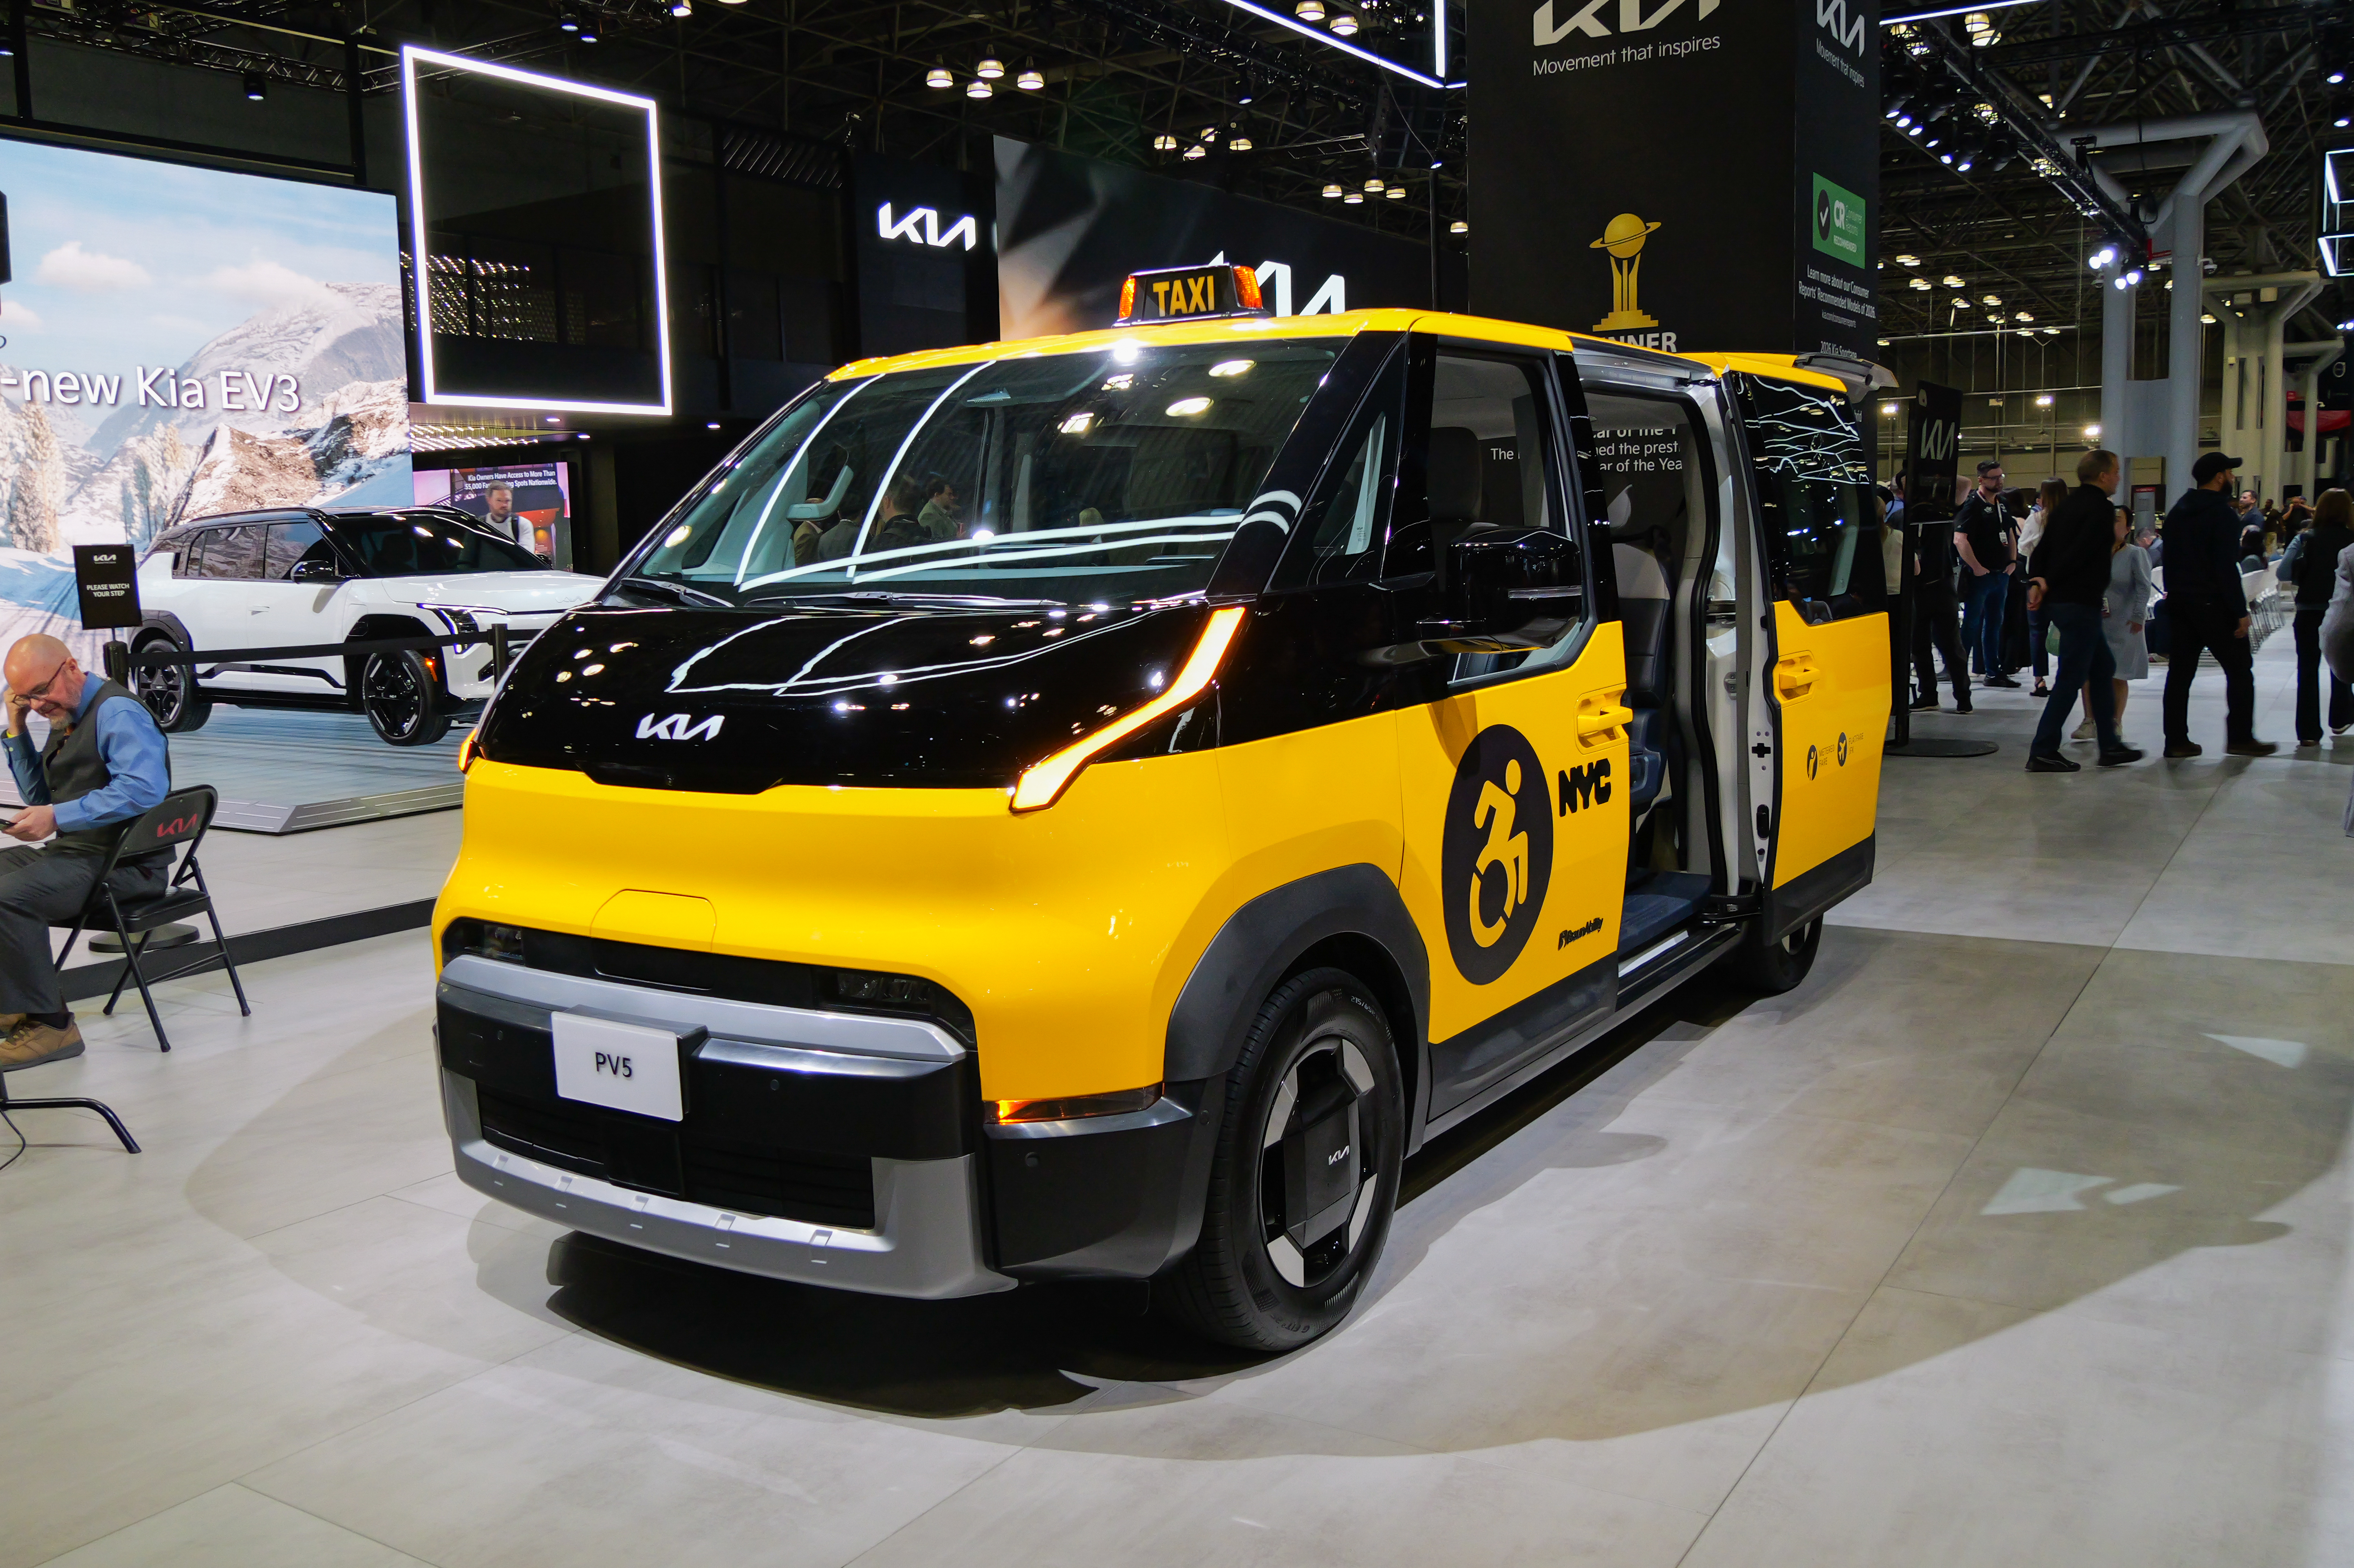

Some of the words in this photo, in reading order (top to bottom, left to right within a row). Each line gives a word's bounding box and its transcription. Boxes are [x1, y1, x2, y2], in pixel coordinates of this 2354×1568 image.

[1533, 50, 1616, 76] Movement
[1620, 44, 1653, 62] that
[1658, 36, 1721, 58] inspires
[1816, 37, 1840, 70] Movement
[1840, 58, 1849, 76] that
[877, 201, 976, 251] KIA
[1834, 200, 1845, 230] CR
[1807, 264, 1820, 281] Learn
[1820, 273, 1831, 285] more
[1831, 274, 1843, 289] about
[1851, 281, 1870, 299] Consumer
[1153, 275, 1215, 317] TAXI
[1817, 287, 1847, 309] Recommended
[1847, 297, 1860, 313] Models
[1861, 303, 1865, 315] of
[1821, 341, 1832, 354] 2026
[136, 366, 204, 408] Kia
[220, 370, 300, 412] EV3
[1490, 448, 1514, 460] The
[1618, 442, 1640, 454] the
[1921, 418, 1955, 460] KIA
[1616, 459, 1630, 472] of
[1633, 459, 1655, 471] the
[514, 480, 528, 488] Spots
[635, 713, 725, 742] KIA
[1819, 744, 1834, 757] METERED
[1819, 758, 1827, 767] FARE
[1558, 758, 1611, 817] NYC
[157, 813, 198, 838] KIA
[595, 1052, 632, 1078] PV5
[1329, 1145, 1349, 1166] KIA
